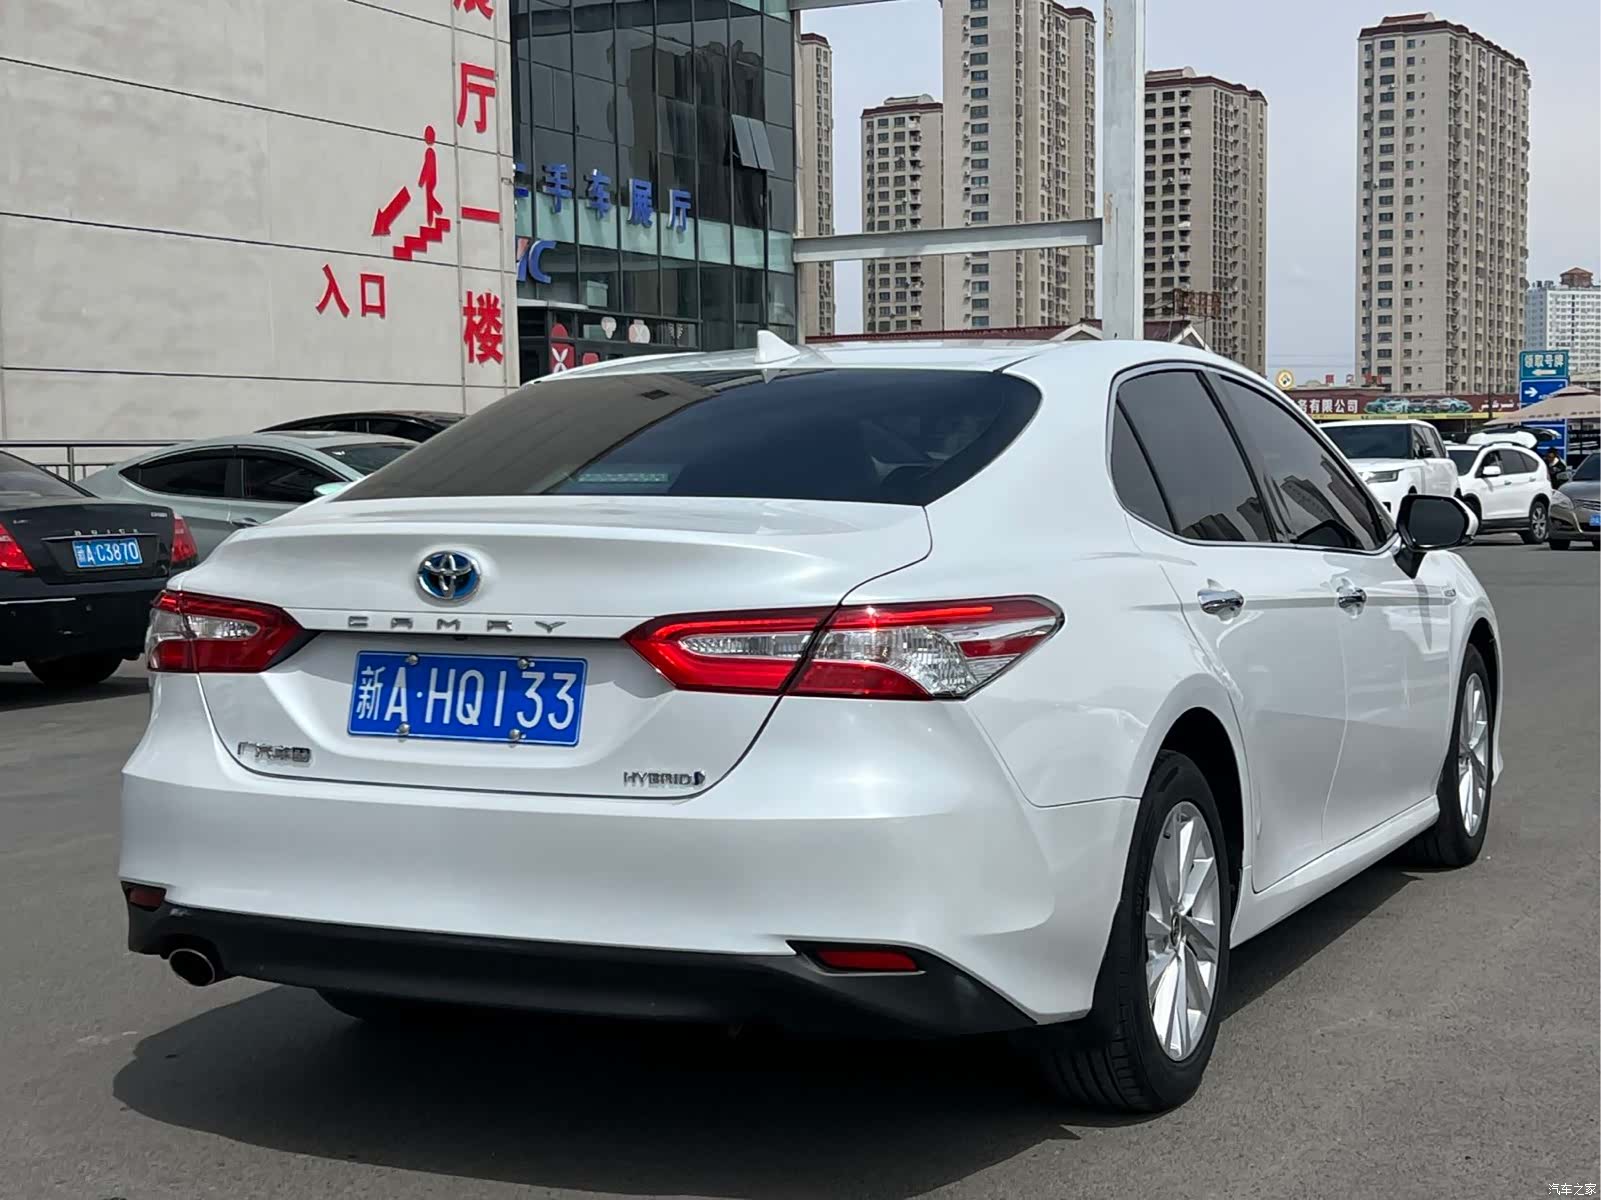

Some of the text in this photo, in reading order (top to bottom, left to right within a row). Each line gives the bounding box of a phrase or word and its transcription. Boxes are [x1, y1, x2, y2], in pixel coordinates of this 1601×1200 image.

[453, 0, 504, 364] 厅一楼
[315, 264, 386, 319] 入口
[348, 616, 566, 633] CAMRY
[623, 771, 692, 786] HYBRID
